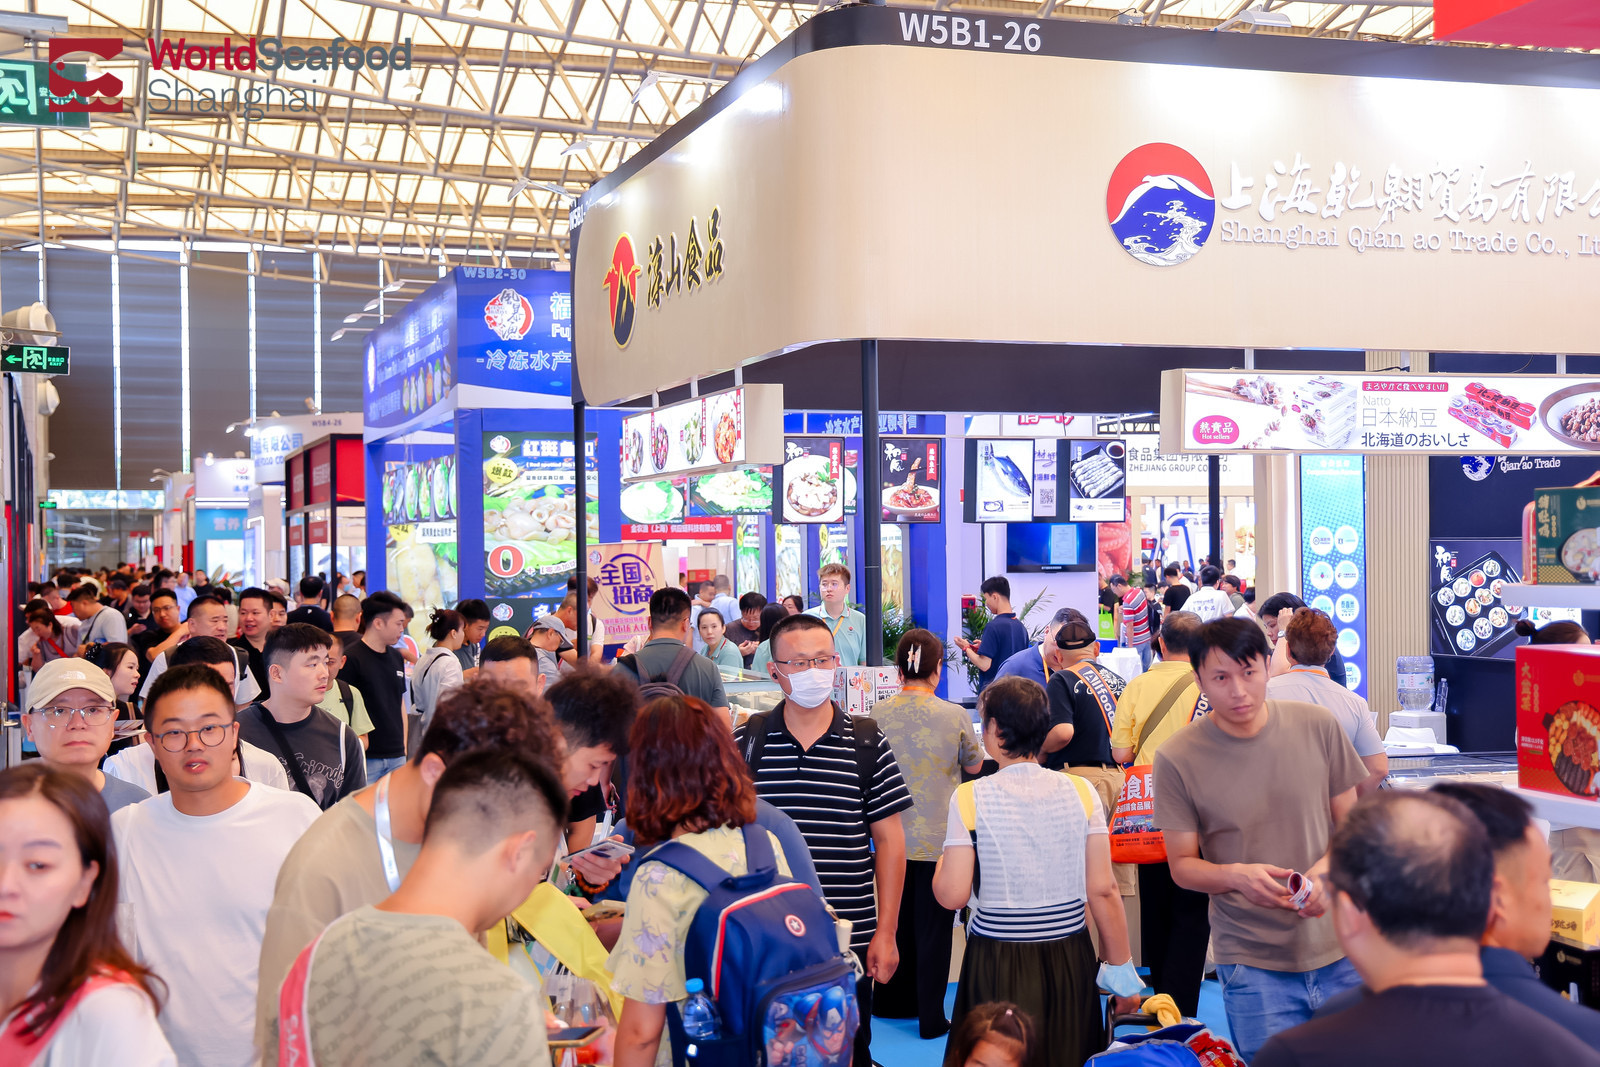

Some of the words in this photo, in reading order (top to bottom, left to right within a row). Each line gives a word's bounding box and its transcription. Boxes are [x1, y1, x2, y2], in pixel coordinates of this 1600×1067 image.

[899, 12, 1041, 52] W5B1-26
[1220, 219, 1340, 250] Shanghai
[1348, 225, 1406, 254] Qian
[1413, 231, 1441, 252] ao
[1449, 229, 1518, 255] Trade
[463, 266, 527, 281] W5B2-30
[1362, 396, 1391, 406] Natto
[1363, 407, 1438, 428] 日本納豆
[1361, 431, 1471, 448] 北海道のおいしさ
[1128, 463, 1166, 472] ZHEJIANG
[1169, 463, 1195, 472] GROUP
[1534, 457, 1560, 469] Trade
[601, 562, 642, 586] 全国
[613, 585, 653, 604] 招商
